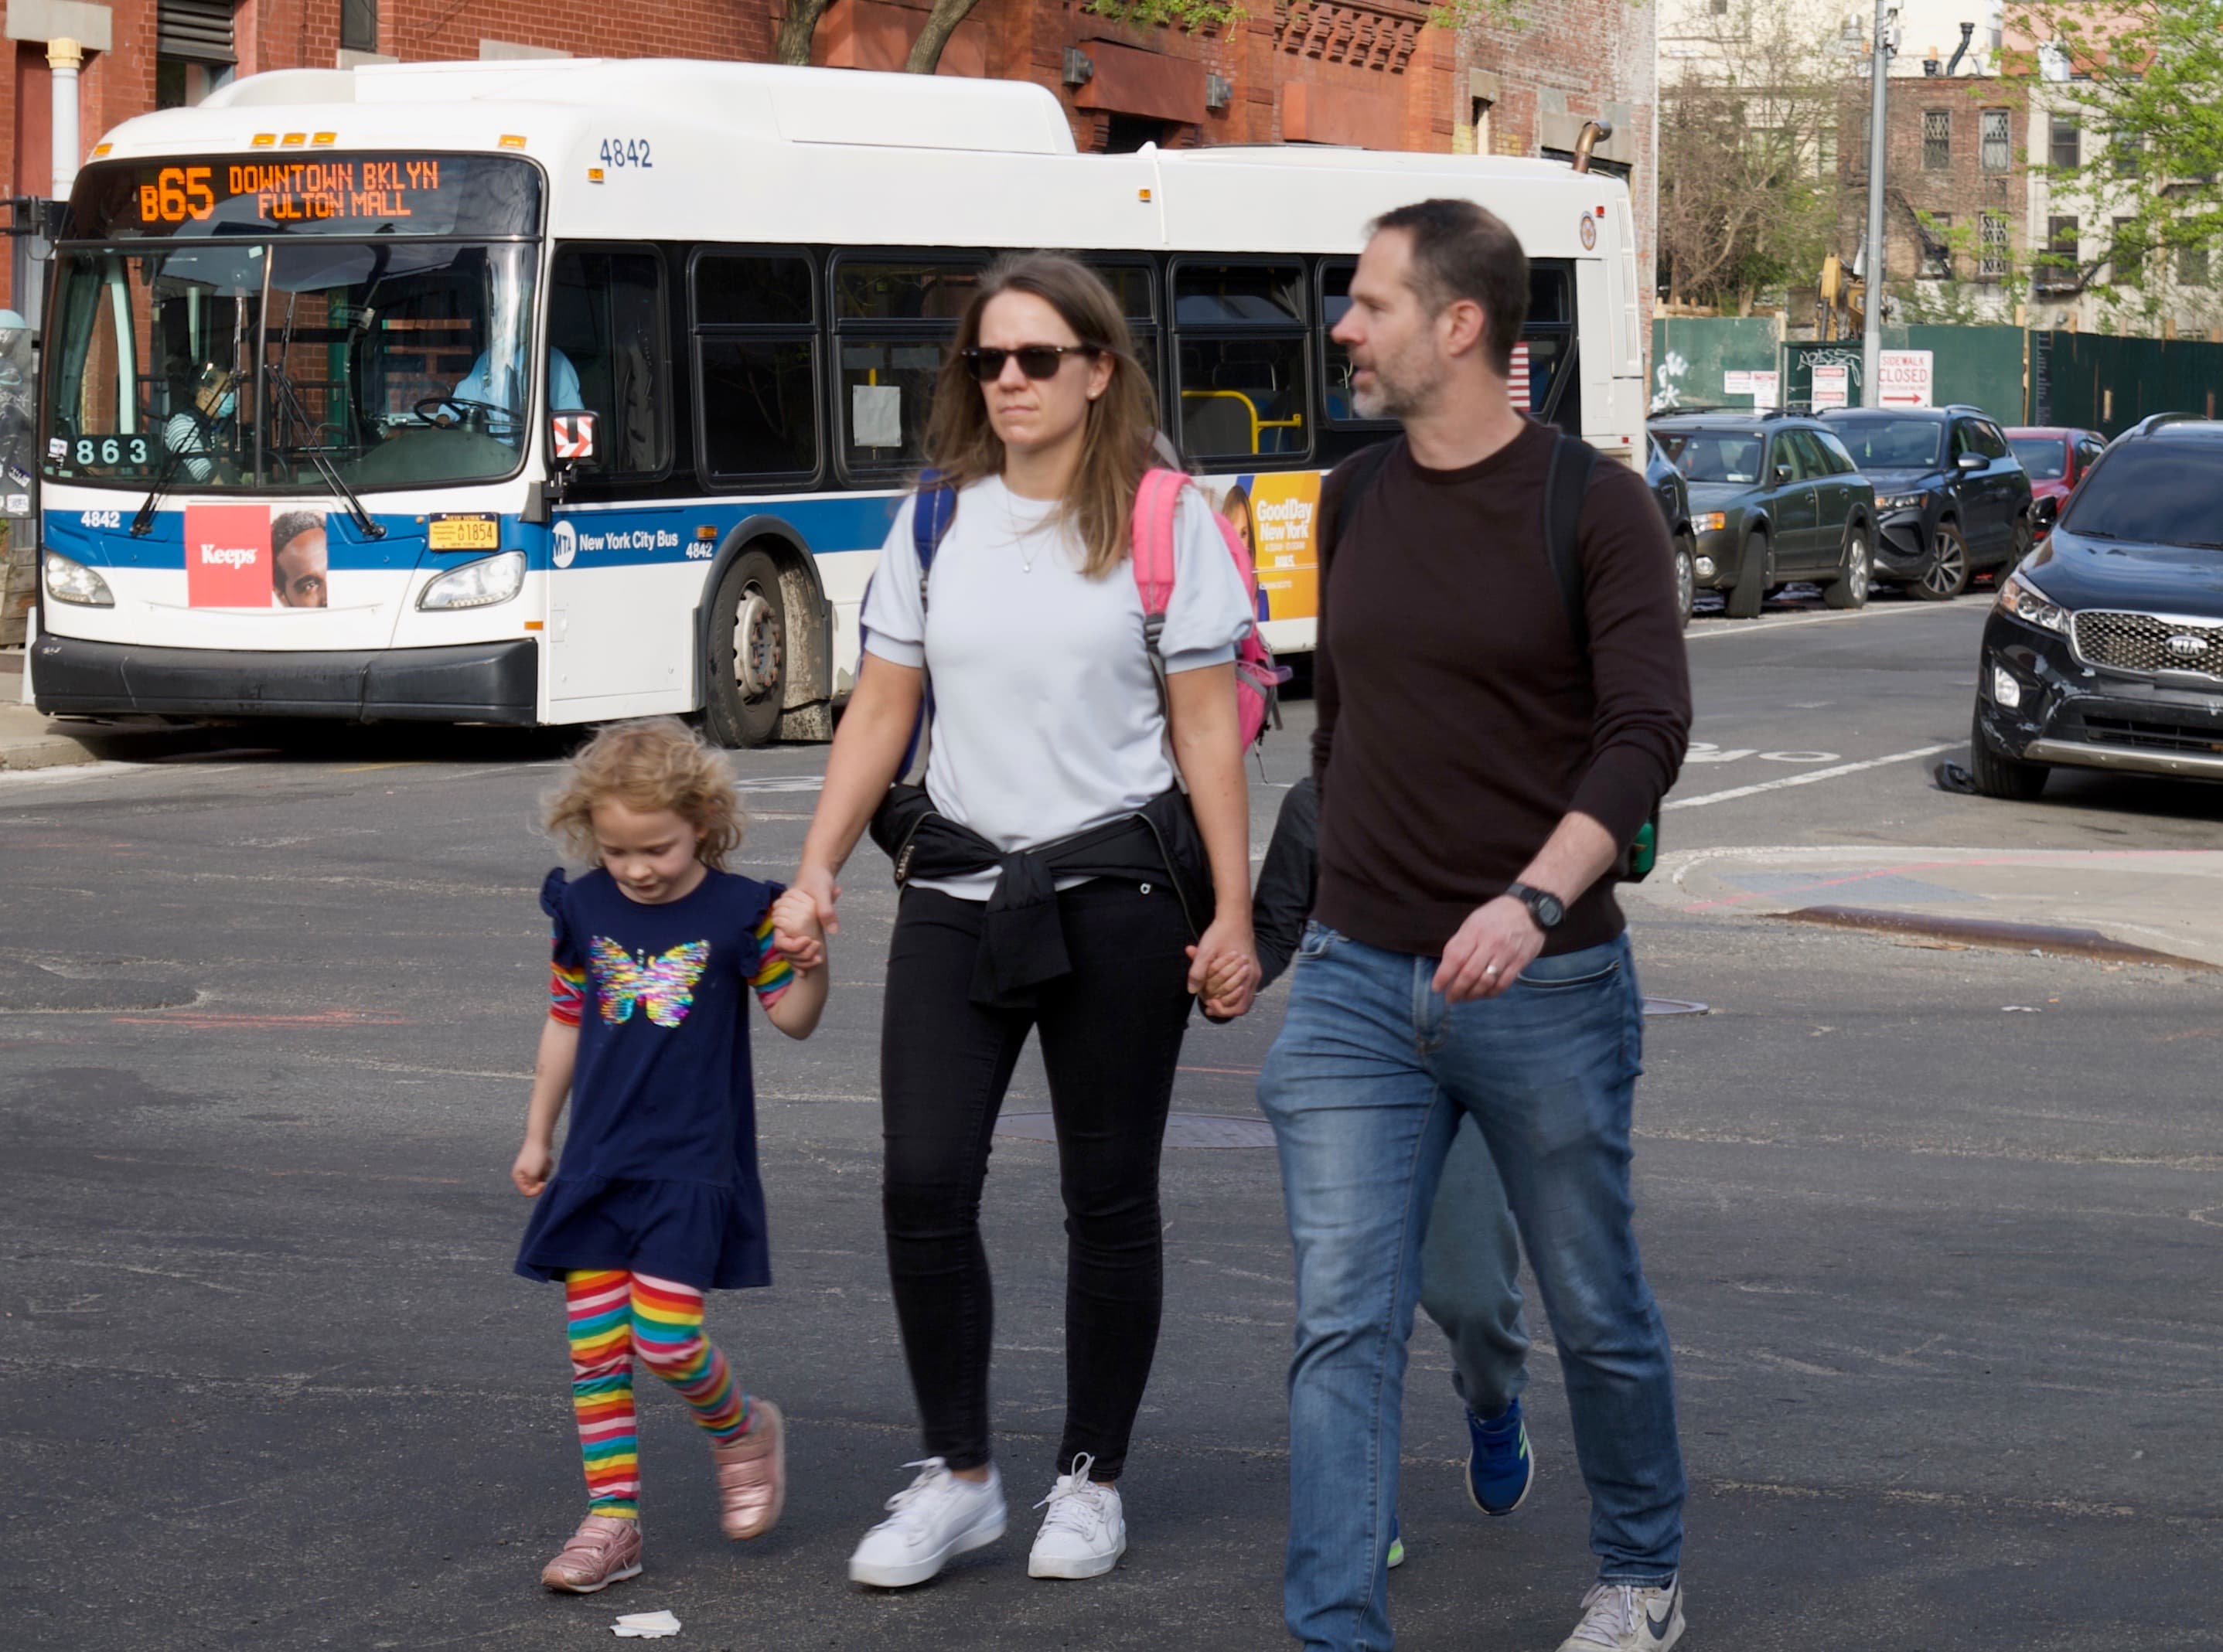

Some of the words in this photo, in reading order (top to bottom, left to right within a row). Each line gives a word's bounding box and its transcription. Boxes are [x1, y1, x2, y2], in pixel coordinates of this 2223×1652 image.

[600, 138, 653, 167] 4842
[140, 166, 215, 223] B65
[229, 163, 353, 194] DOWNTOWN
[363, 160, 438, 190] BKLYN
[257, 192, 345, 220] FULTON
[351, 191, 412, 216] MALL
[1881, 356, 1925, 366] SIDEWALK
[1878, 369, 1928, 383] CLOSED
[76, 438, 148, 465] 863
[80, 511, 121, 528] 4842
[467, 523, 493, 541] 1854
[579, 534, 605, 551] New
[605, 532, 630, 550] York
[632, 530, 656, 551] City
[656, 530, 679, 547] Bus
[1260, 523, 1285, 541] New
[1286, 520, 1309, 539] York
[552, 531, 571, 558] MTA
[685, 542, 713, 559] 4842
[200, 543, 258, 570] Keeps
[2171, 639, 2201, 655] KIA
